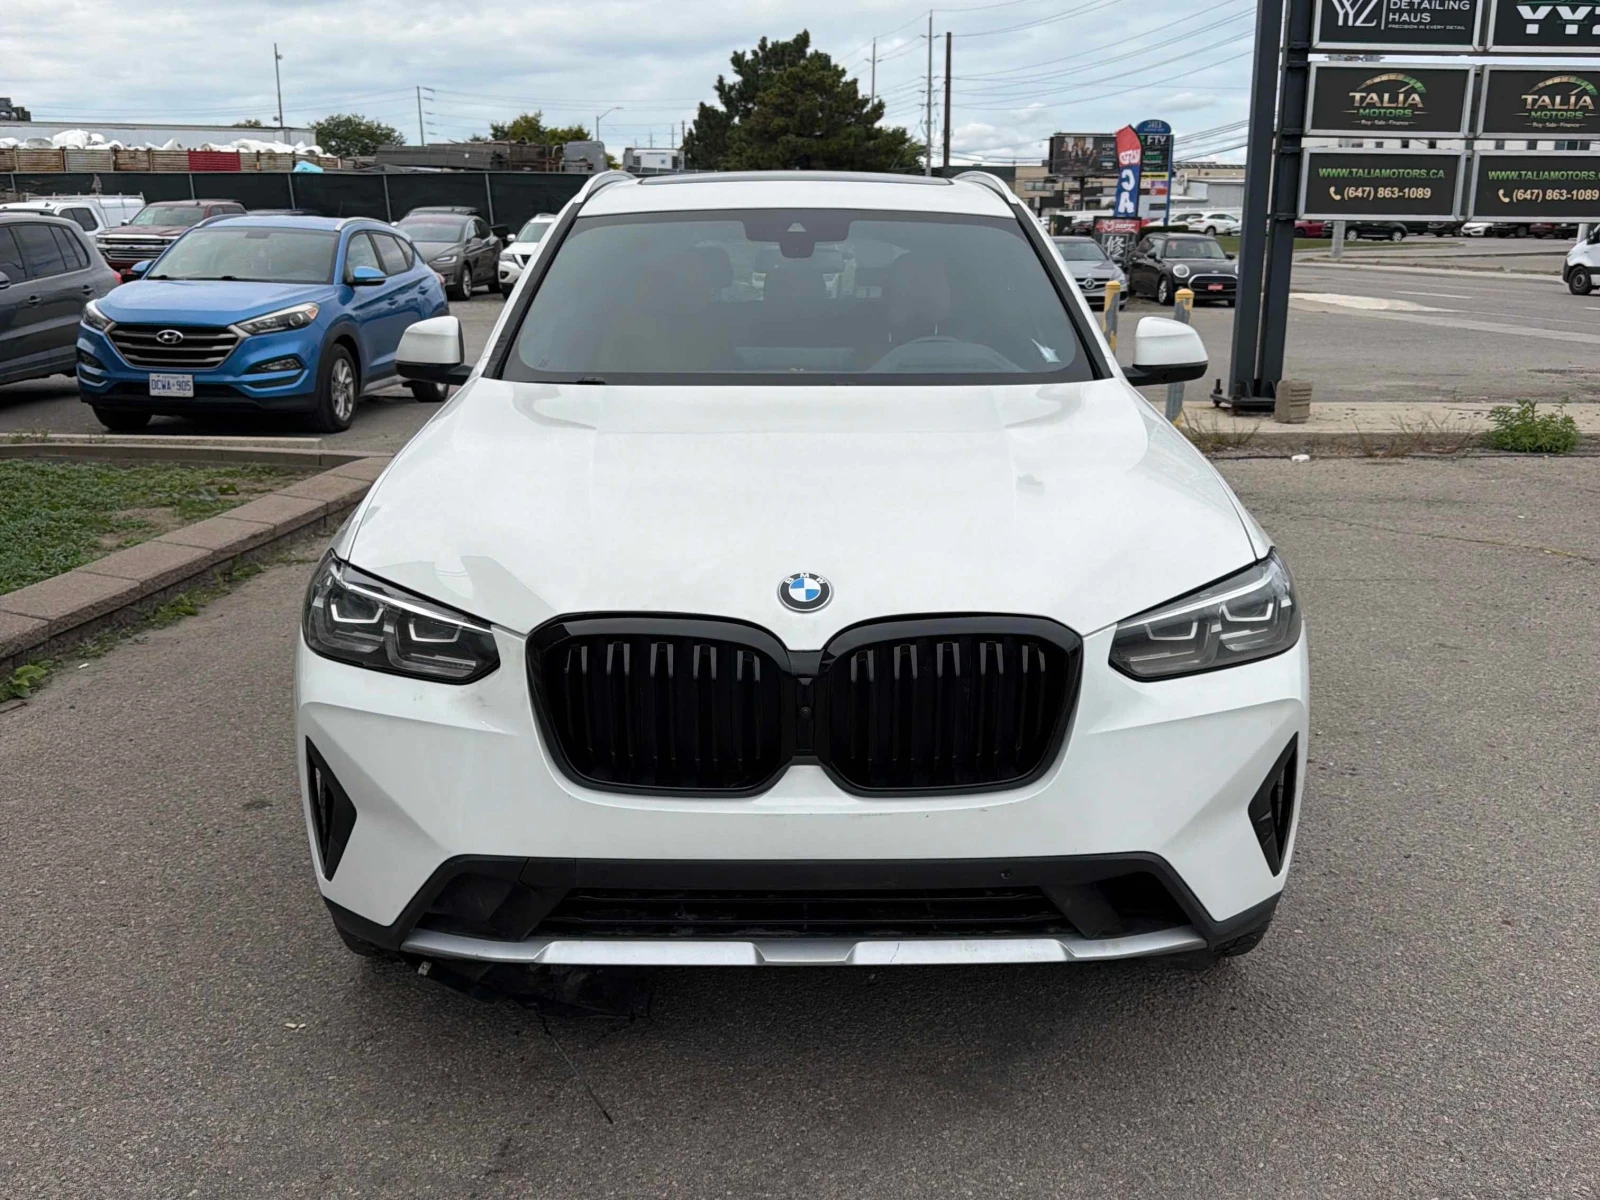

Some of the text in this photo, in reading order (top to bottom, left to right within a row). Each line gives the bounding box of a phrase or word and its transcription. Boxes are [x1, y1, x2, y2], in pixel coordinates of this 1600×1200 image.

[1389, 0, 1471, 11] DETAILING
[1388, 12, 1431, 23] HAUS
[1516, 5, 1600, 35] YY
[1349, 92, 1424, 108] TALIA
[1521, 95, 1595, 110] TALIA
[1359, 108, 1413, 117] MOTORS
[1530, 111, 1584, 119] MOTORS
[1318, 168, 1445, 178] WWW.TALIAMOTORS.CA
[1487, 170, 1600, 181] WWW.TALIAMOTORS.
[1344, 187, 1432, 201] (647) 863-1089
[1513, 189, 1600, 203] (647) 863-1089
[784, 572, 826, 584] BMW
